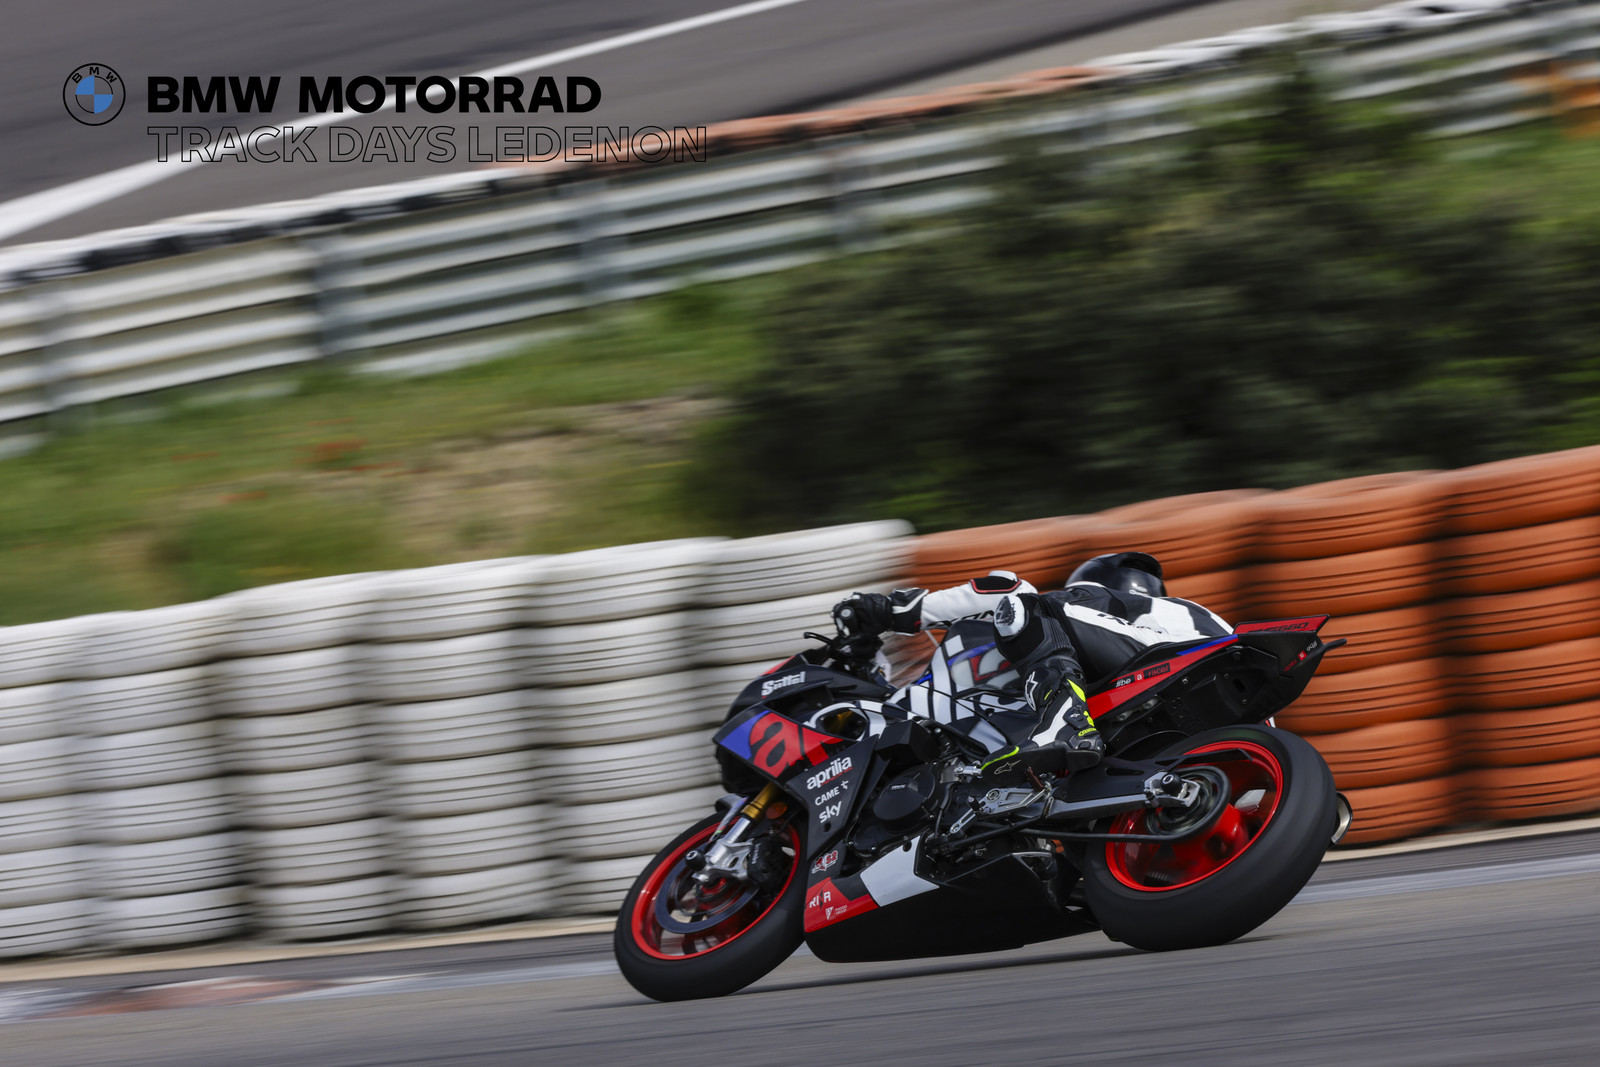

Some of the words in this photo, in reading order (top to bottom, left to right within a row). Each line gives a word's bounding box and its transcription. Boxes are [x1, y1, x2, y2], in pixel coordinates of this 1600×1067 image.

[806, 756, 852, 790] aprilia
[815, 786, 840, 806] CAME
[819, 800, 842, 823] sky
